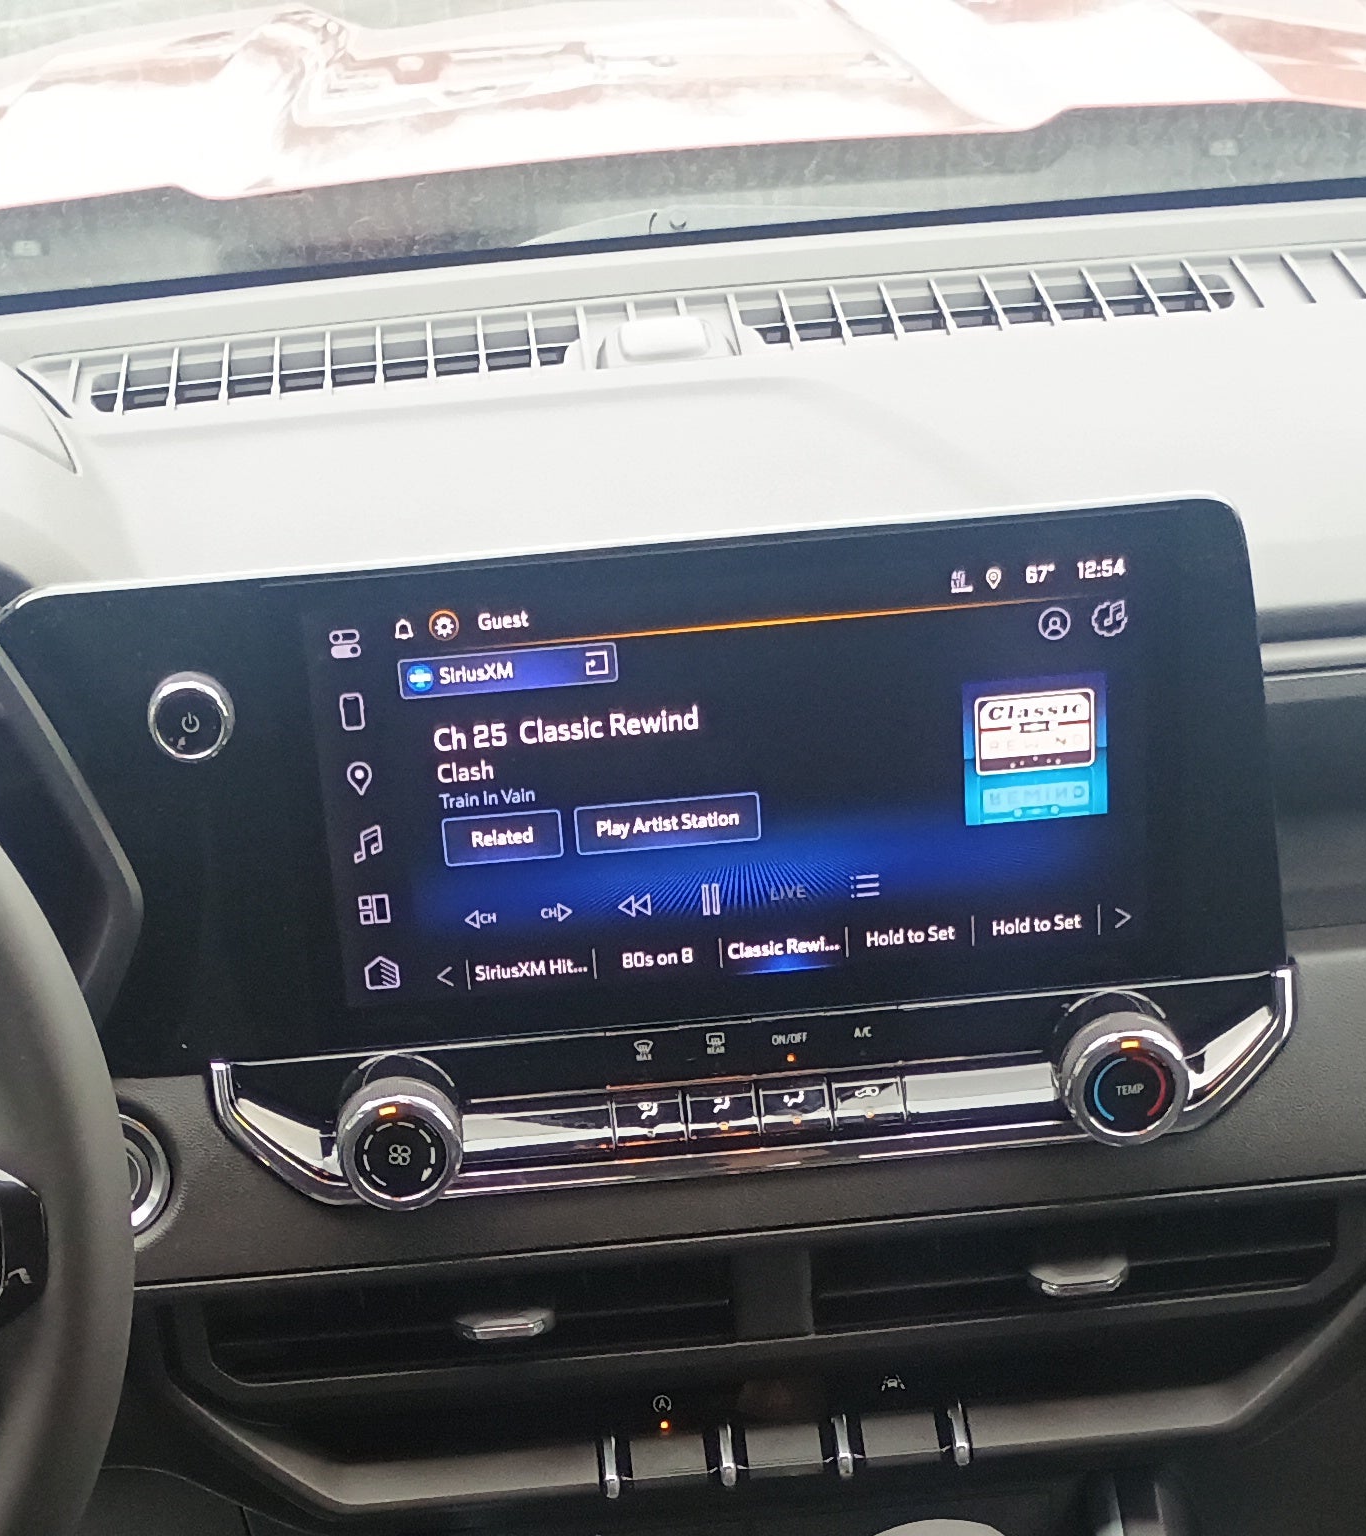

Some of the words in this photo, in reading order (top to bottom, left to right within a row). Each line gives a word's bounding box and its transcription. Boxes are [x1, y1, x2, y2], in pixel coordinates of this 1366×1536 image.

[1077, 557, 1126, 579] 12:54
[477, 611, 529, 631] Guest
[439, 661, 515, 686] SiriusXM
[988, 703, 1082, 721] Classic
[433, 724, 467, 753] Ch
[473, 722, 508, 748] 25
[519, 715, 604, 745] Classic
[609, 705, 700, 737] Rewind
[437, 760, 495, 785] Clash
[439, 791, 480, 810] Train
[501, 788, 536, 806] Vain
[596, 817, 630, 839] Play
[632, 813, 679, 835] Artist
[681, 810, 740, 832] Station
[470, 827, 534, 848] Related
[769, 883, 807, 901] LIVE
[479, 912, 497, 925] CH
[540, 907, 558, 919] CH
[991, 918, 1031, 937] Hold
[1033, 917, 1051, 934] to
[1053, 914, 1082, 931] Set
[865, 929, 905, 948] Hold
[907, 927, 925, 945] to
[927, 925, 956, 943] Set
[622, 951, 654, 969] 80s
[656, 952, 679, 966] on
[681, 947, 694, 964] 8
[727, 938, 784, 961] Classic
[475, 961, 546, 982] SiriusXM
[771, 1032, 808, 1046] ON/OFF
[853, 1026, 873, 1039] A/C
[1115, 1081, 1144, 1098] TEMP
